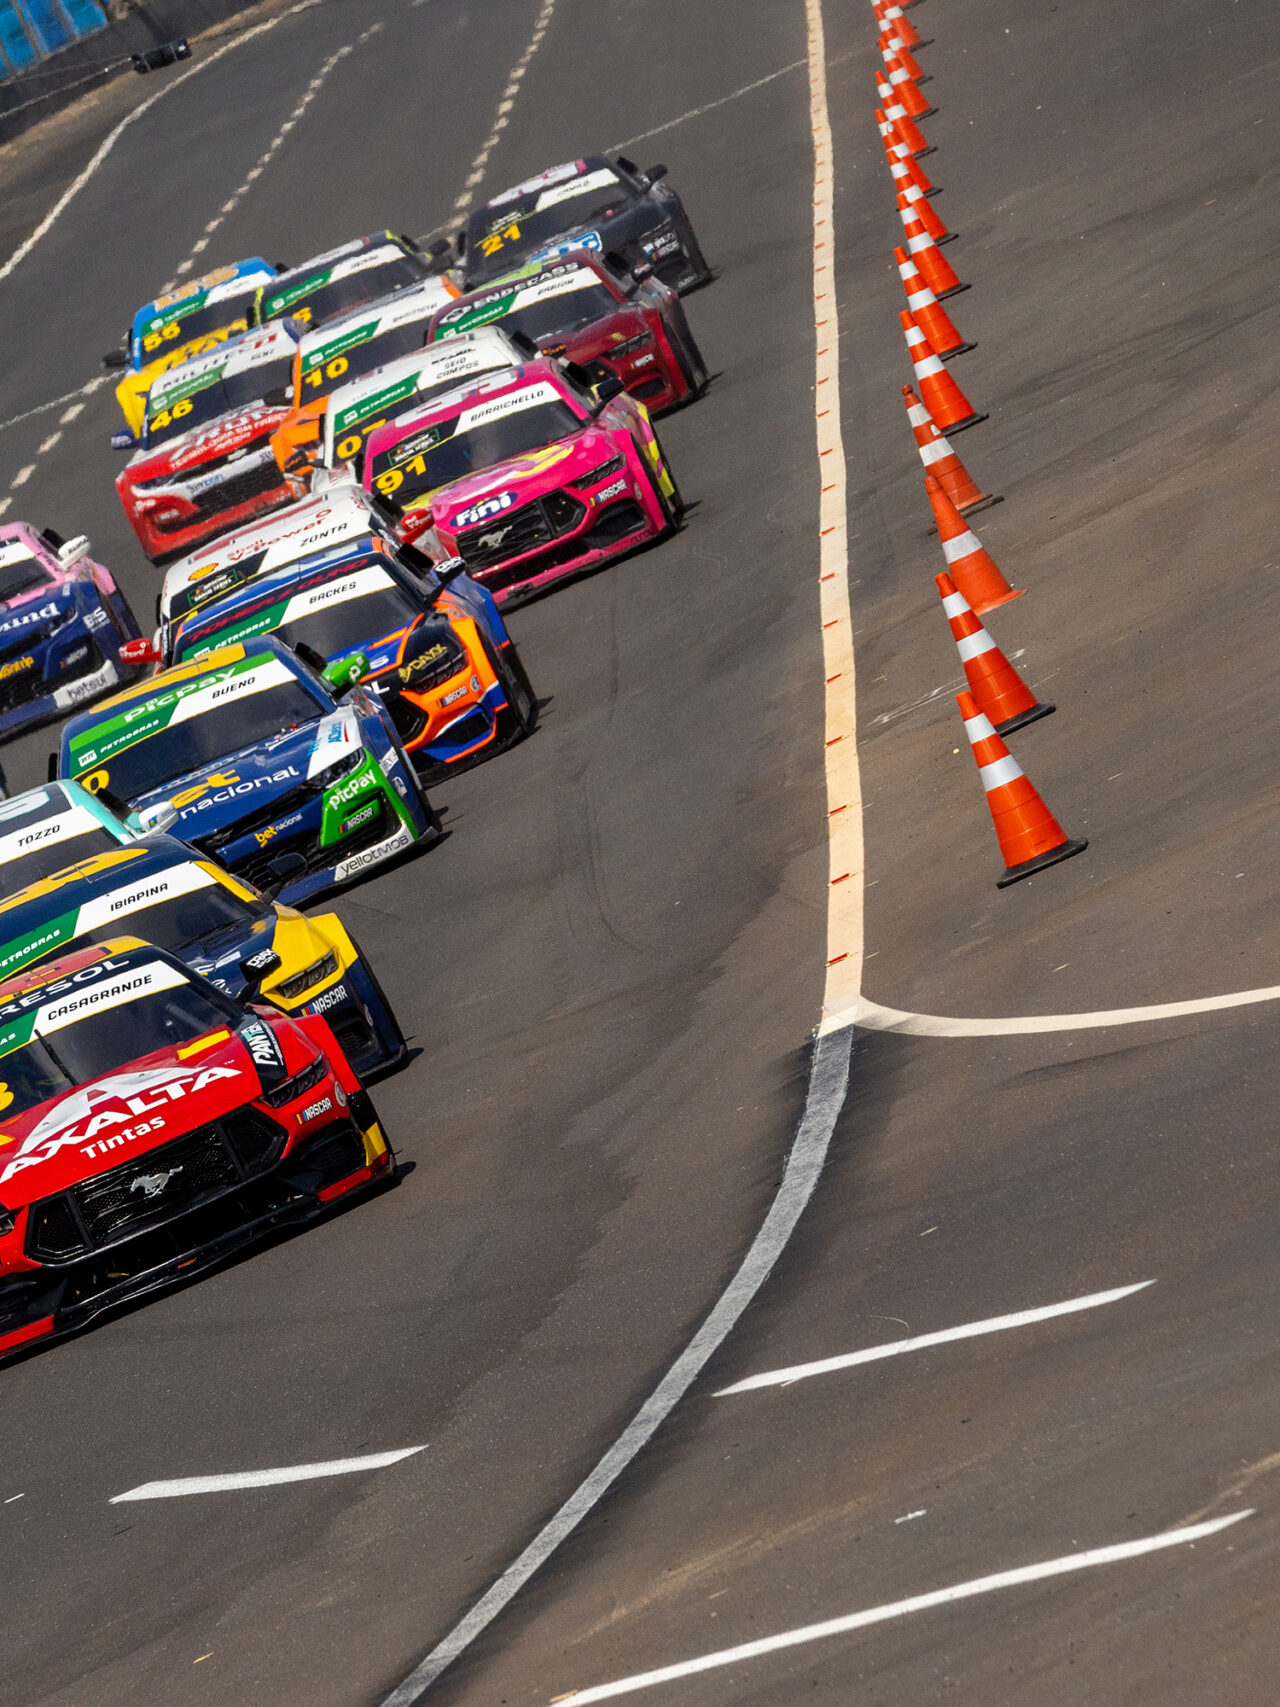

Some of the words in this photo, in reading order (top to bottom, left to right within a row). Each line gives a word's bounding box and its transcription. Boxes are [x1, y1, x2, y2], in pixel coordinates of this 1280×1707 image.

[481, 224, 521, 258] 21
[305, 357, 349, 388] 10
[150, 399, 194, 432] 46
[470, 389, 544, 423] BARRICHELLO
[376, 455, 426, 495] 91
[597, 479, 628, 503] NASCAR
[300, 523, 348, 548] ZONTA
[309, 580, 357, 604] BACKES
[212, 676, 256, 700] BUENO
[100, 719, 160, 753] PETROBRAS
[181, 765, 300, 819] nacional
[329, 769, 377, 811] PicPay
[254, 826, 278, 848] bet
[276, 813, 303, 831] nacional
[347, 808, 373, 830] NASCAR
[17, 824, 61, 848] TOZZO
[110, 882, 169, 912] IBIAPINA
[47, 974, 153, 1022] CASAGRANDE
[312, 984, 348, 1014] NASCAR
[304, 1097, 333, 1120] NASCAR
[80, 1115, 166, 1161] Tintas
